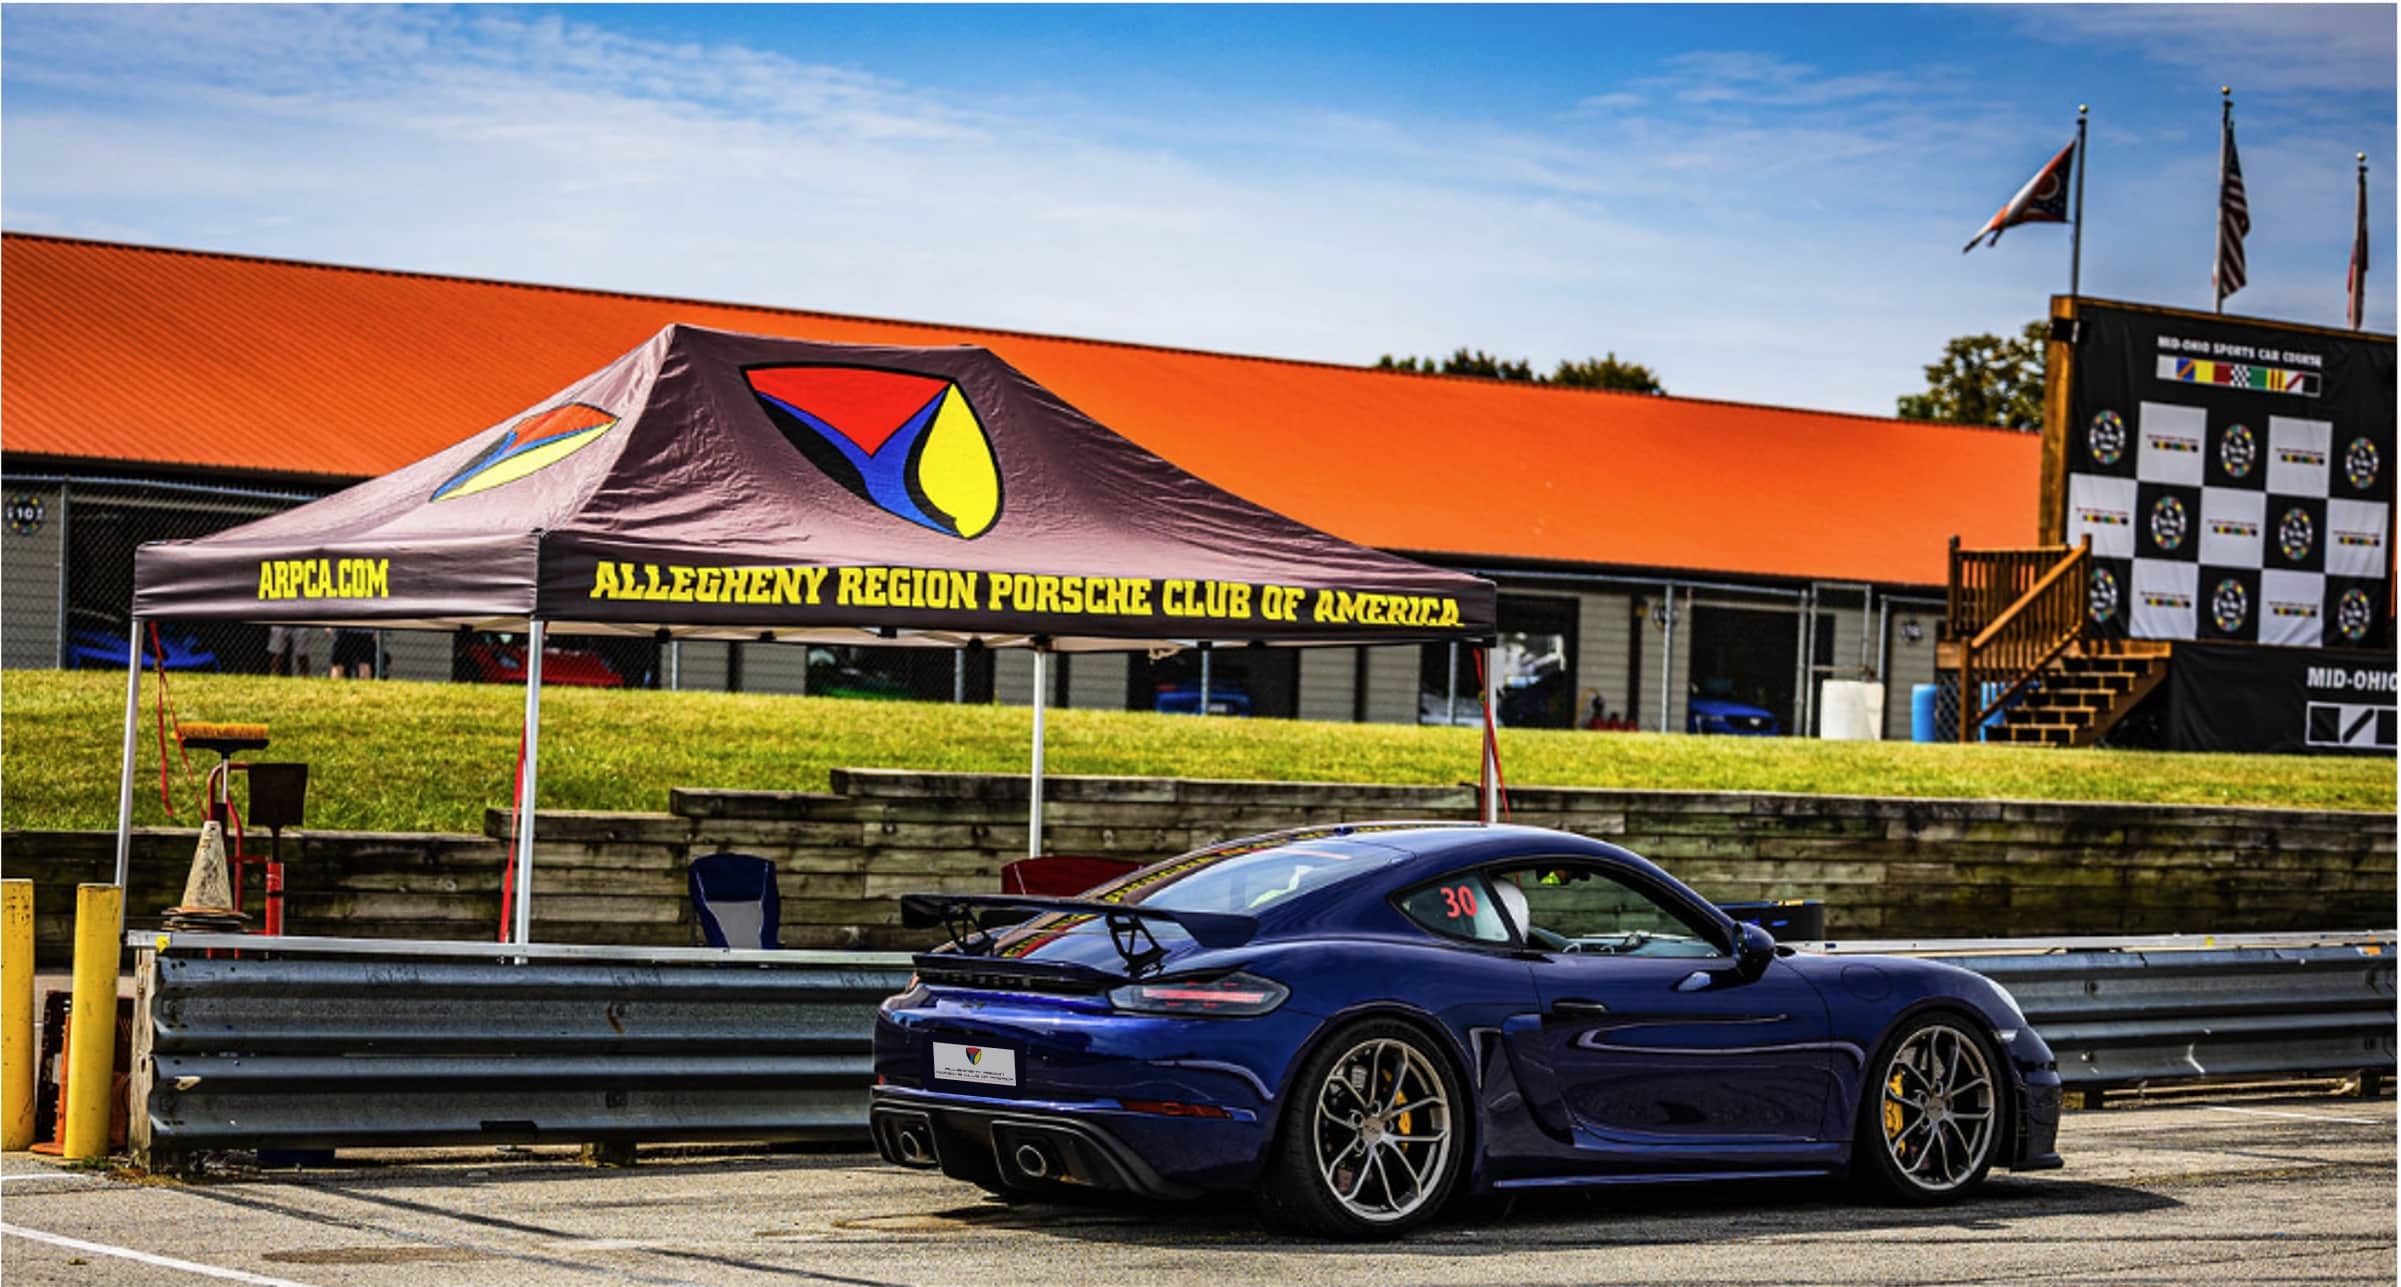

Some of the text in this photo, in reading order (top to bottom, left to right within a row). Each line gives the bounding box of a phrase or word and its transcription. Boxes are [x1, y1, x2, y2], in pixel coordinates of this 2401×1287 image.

[2213, 342, 2254, 358] SPORTS
[2257, 348, 2279, 361] CAR
[258, 558, 390, 600] ARPCA.COM
[589, 561, 1465, 627] ALLEGHENY REGION PORSCHE CLUB OF AMERICA
[1440, 885, 1478, 918] 30
